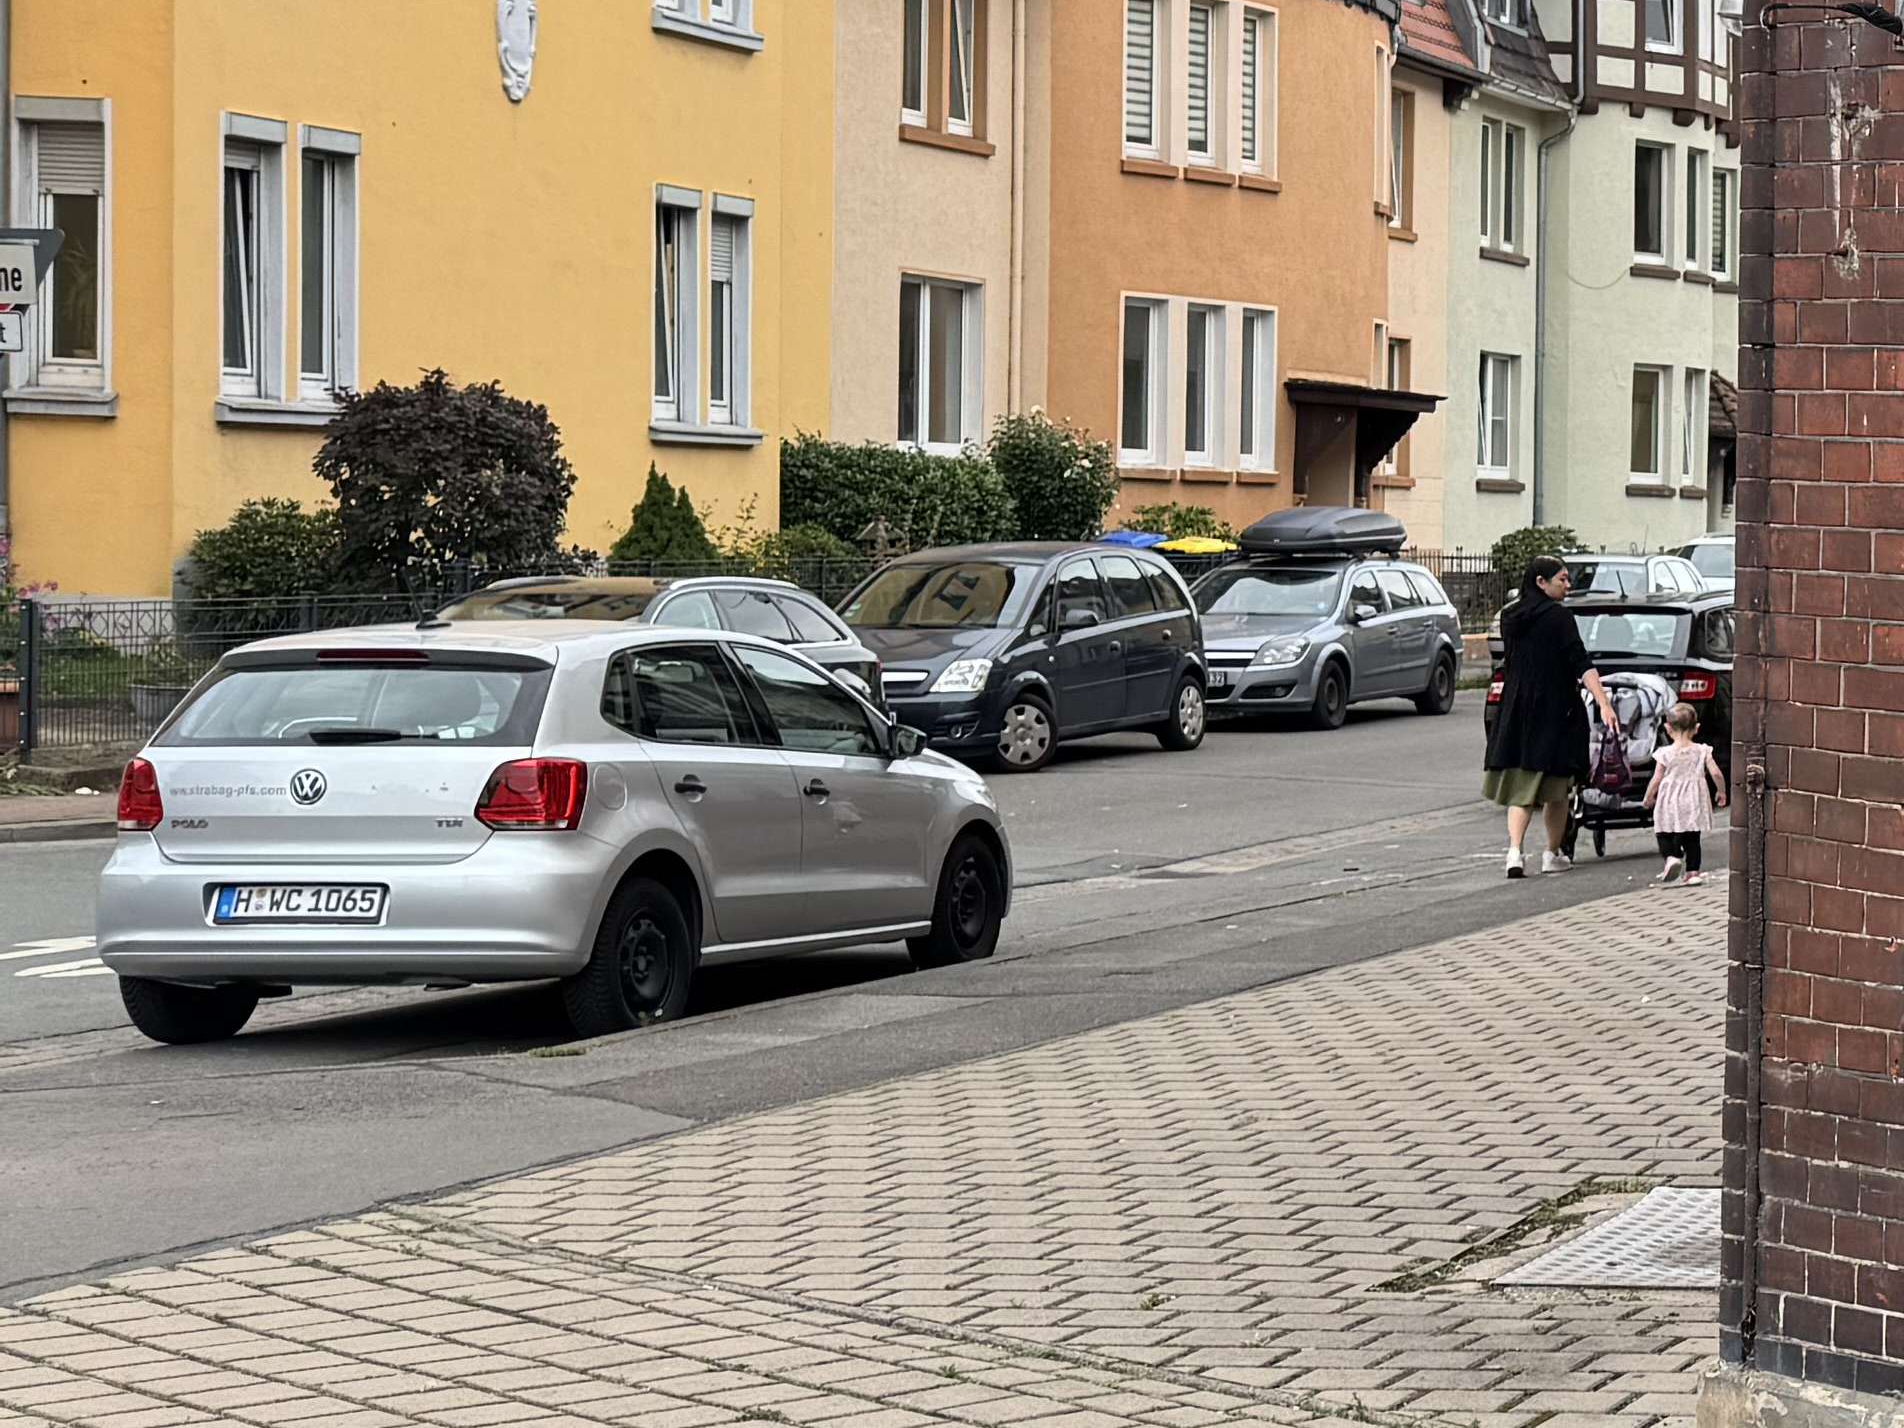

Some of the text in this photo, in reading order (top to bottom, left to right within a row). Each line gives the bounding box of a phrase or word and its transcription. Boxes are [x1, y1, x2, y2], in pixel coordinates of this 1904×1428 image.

[234, 889, 377, 913] H WC 1065
